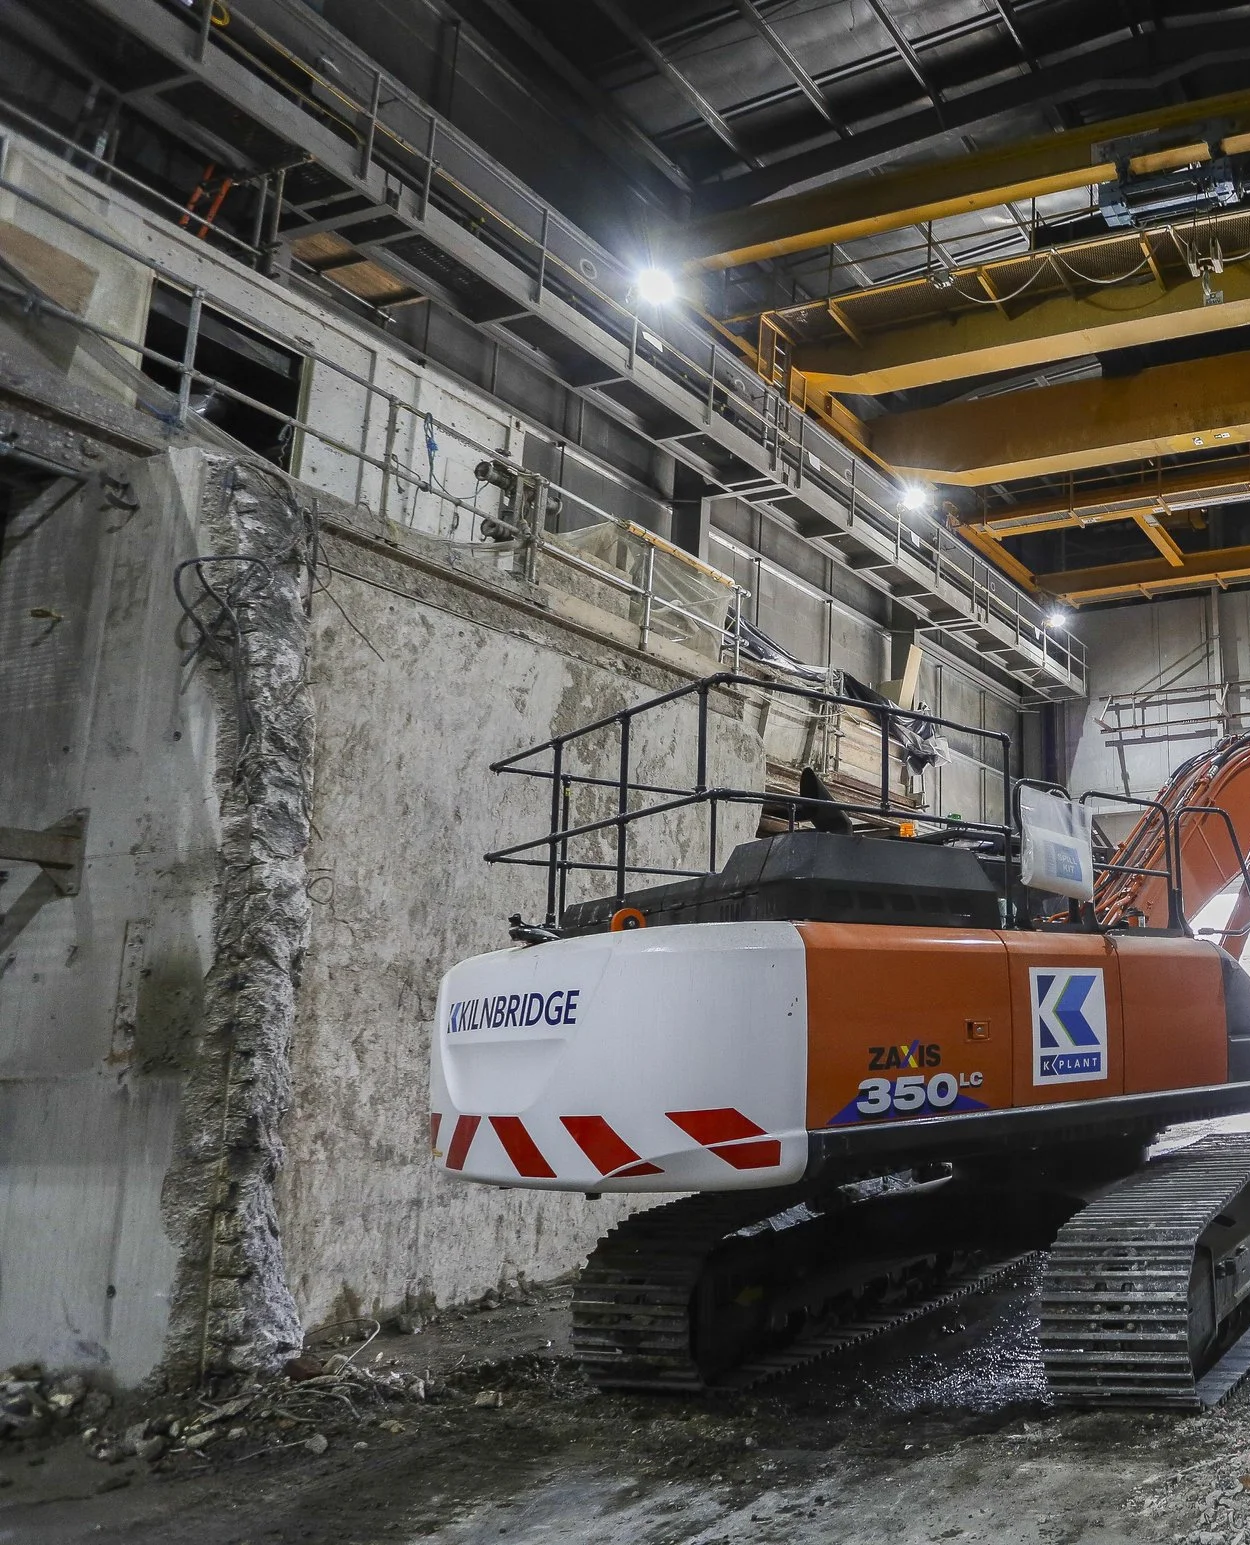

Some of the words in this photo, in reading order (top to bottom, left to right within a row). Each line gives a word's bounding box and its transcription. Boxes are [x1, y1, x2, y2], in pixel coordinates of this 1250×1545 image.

[1057, 853, 1078, 866] SPILL
[1062, 864, 1075, 874] KIT
[868, 1039, 941, 1072] ZAXIS
[1059, 1057, 1098, 1069] PLANT
